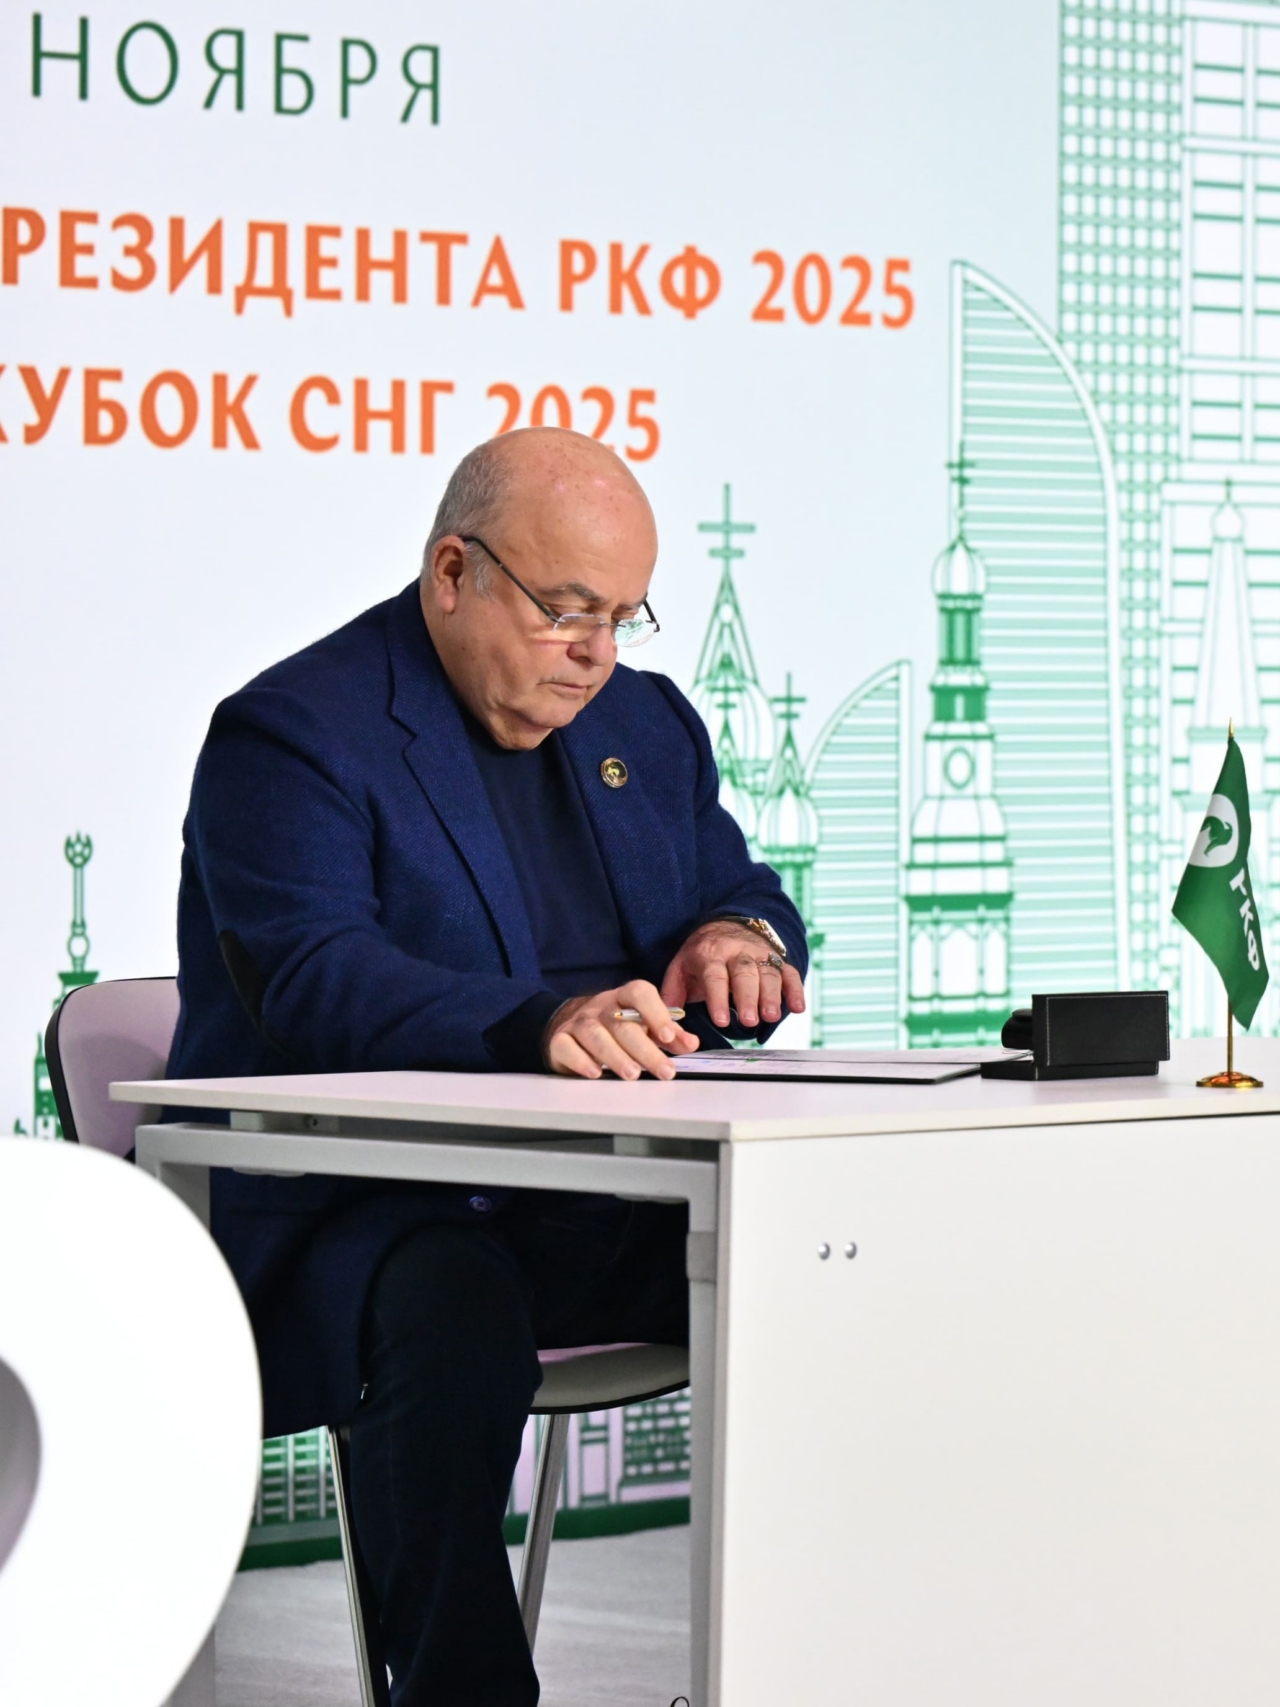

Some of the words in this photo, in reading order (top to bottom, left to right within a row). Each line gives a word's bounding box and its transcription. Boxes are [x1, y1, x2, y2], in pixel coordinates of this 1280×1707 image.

[30, 13, 441, 125] НОЯБРЯ
[557, 236, 724, 322] РКФ
[749, 248, 916, 331] 2025
[287, 373, 457, 457] СНГ
[485, 381, 661, 464] 2025
